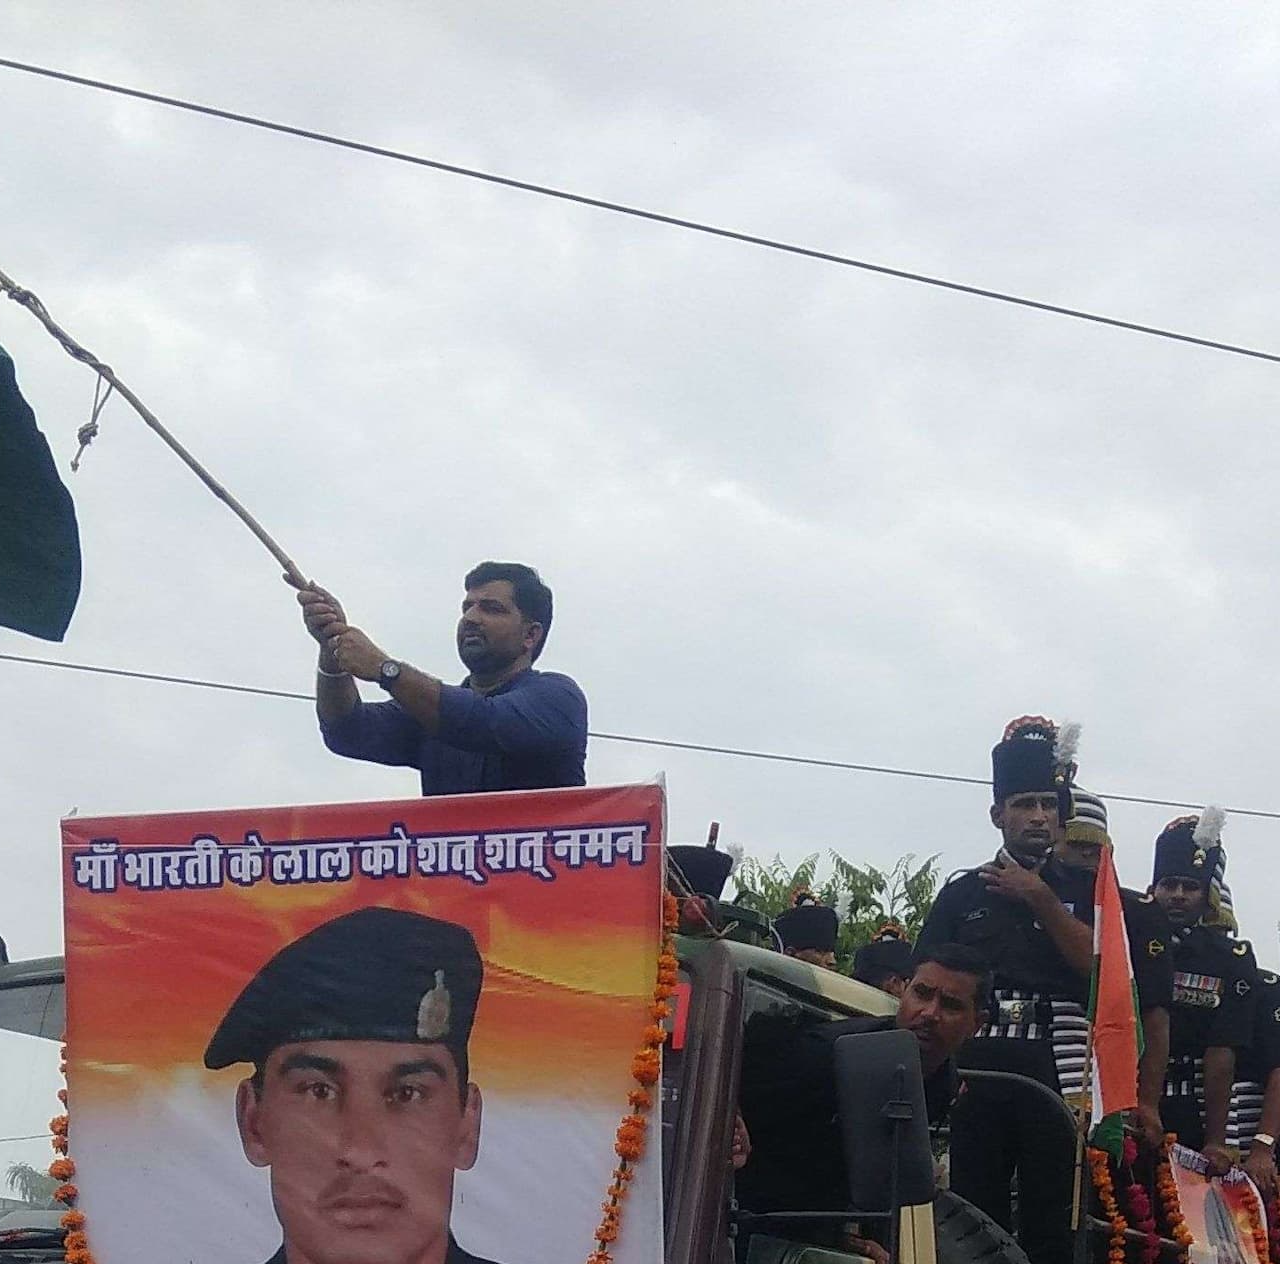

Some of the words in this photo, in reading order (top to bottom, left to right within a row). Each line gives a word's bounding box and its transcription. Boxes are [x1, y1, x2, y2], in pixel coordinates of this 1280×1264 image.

[123, 839, 222, 888] भारती
[228, 835, 264, 882] के
[270, 842, 354, 881] लाल
[358, 827, 410, 875] को
[416, 834, 484, 882] शत्
[484, 831, 553, 878] शत्
[553, 825, 647, 865] नमन
